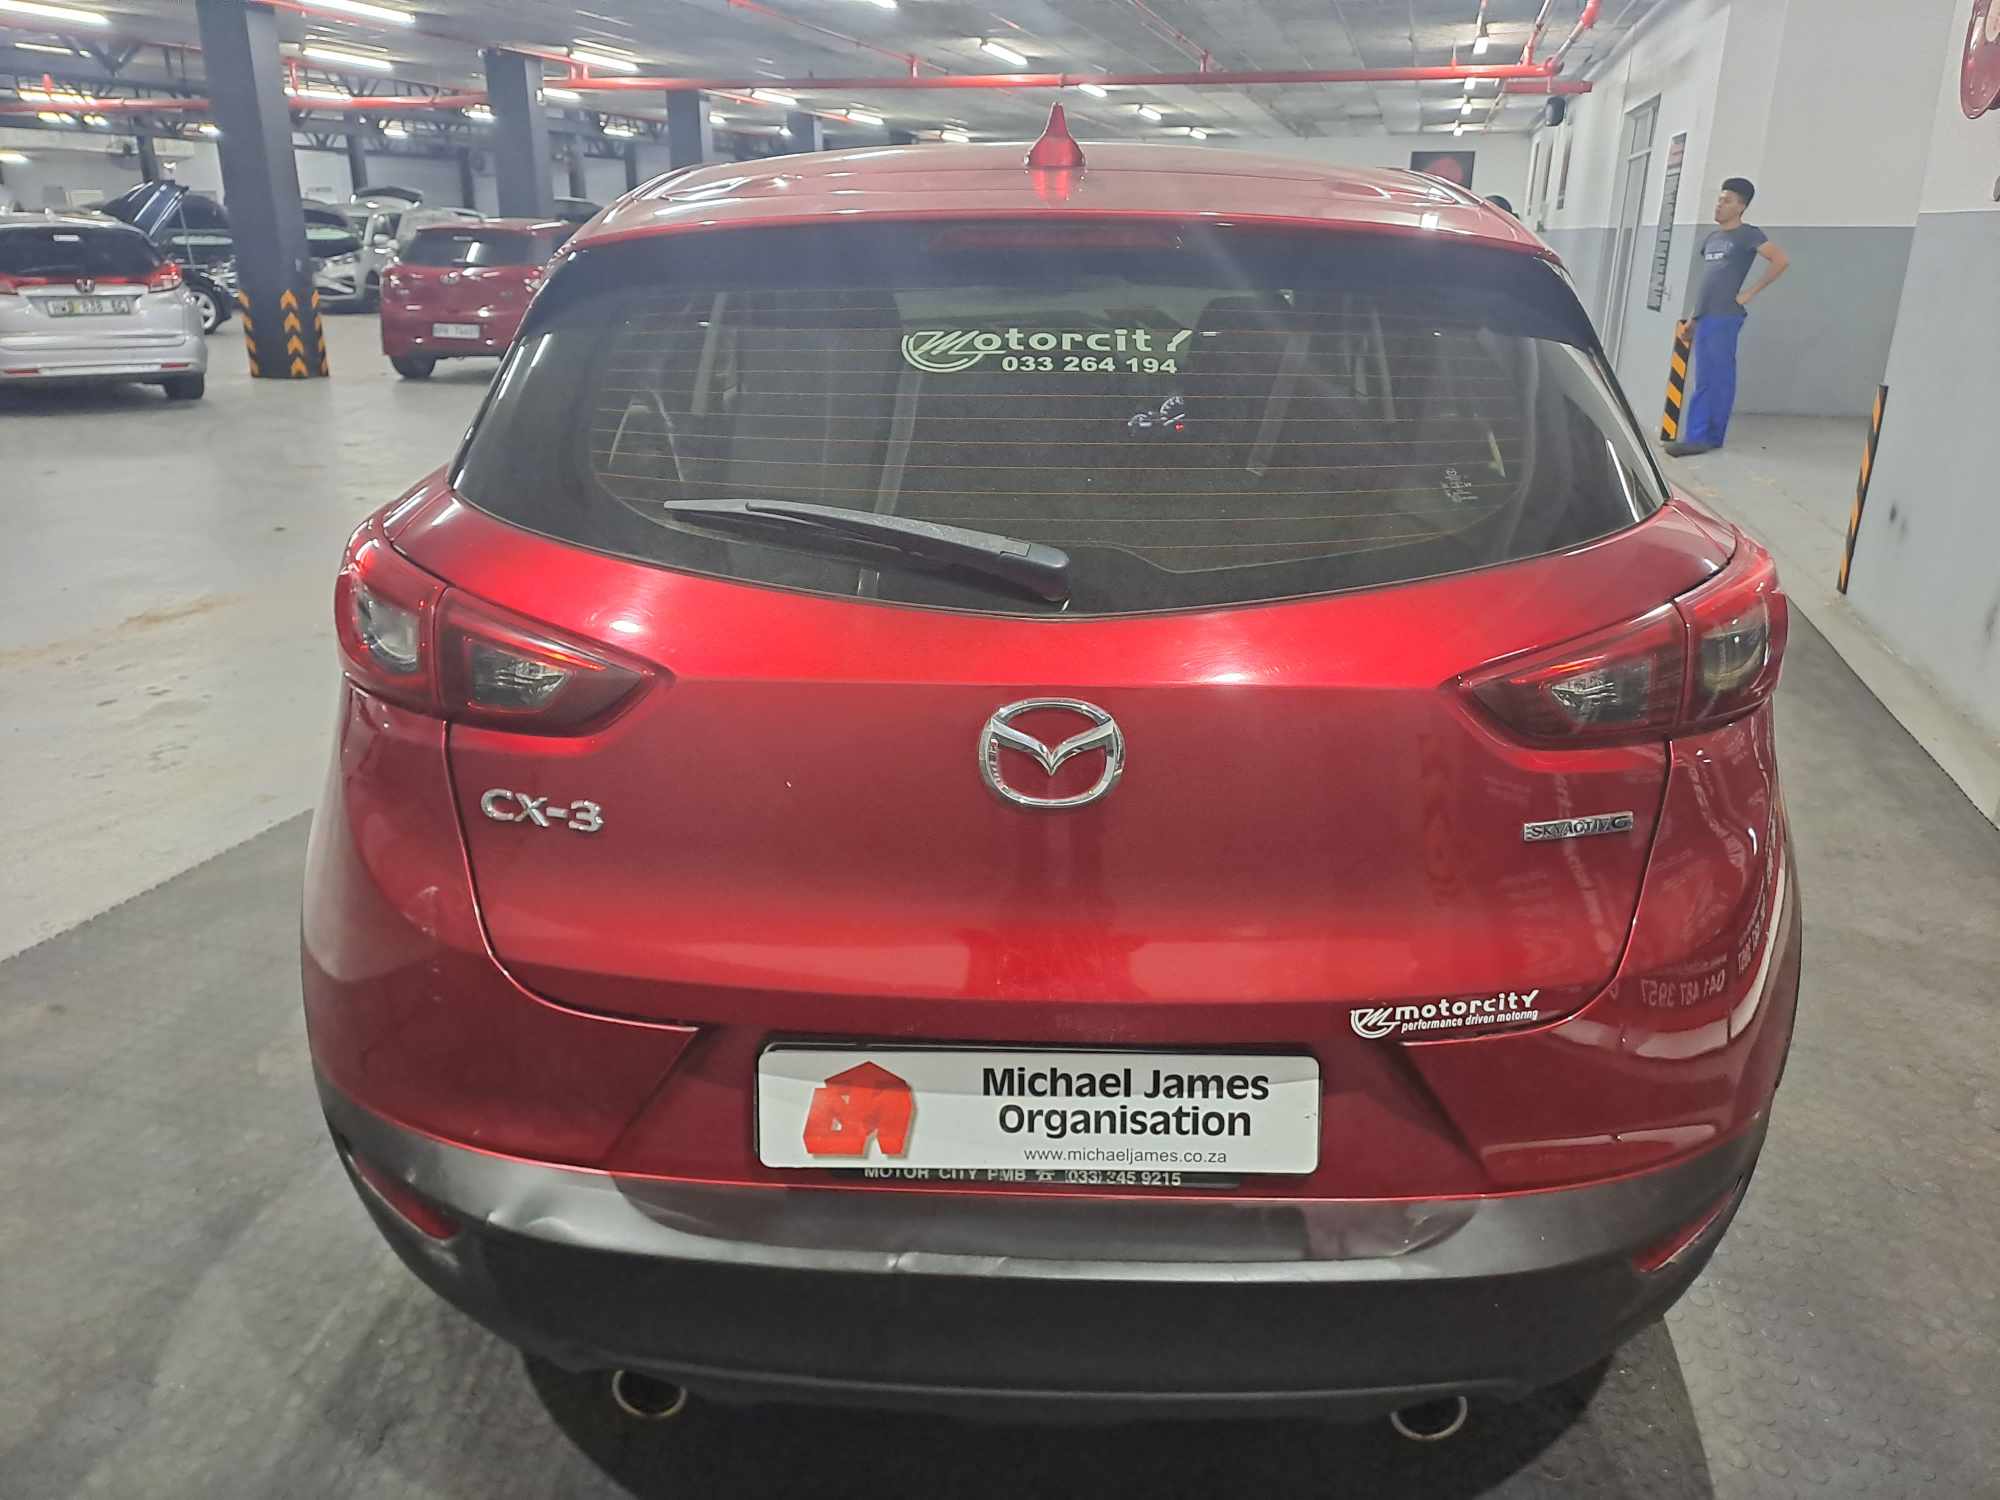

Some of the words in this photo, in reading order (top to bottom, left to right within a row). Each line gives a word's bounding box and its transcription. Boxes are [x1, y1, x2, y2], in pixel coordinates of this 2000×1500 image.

[1001, 356, 1054, 371] 033
[1063, 356, 1115, 371] 264
[1126, 357, 1178, 373] 194
[480, 788, 604, 832] CX-3
[1401, 1018, 1462, 1033] performance
[1465, 1012, 1494, 1026] driven
[1496, 1010, 1539, 1023] motoring
[982, 1067, 1132, 1098] Michael
[1143, 1069, 1269, 1100] James
[998, 1104, 1252, 1139] Organisation
[1024, 1146, 1227, 1164] www.michaeljames.co.za
[864, 1167, 929, 1180] MOTOR
[938, 1168, 977, 1180] CITY
[1141, 1171, 1181, 1187] 9215
